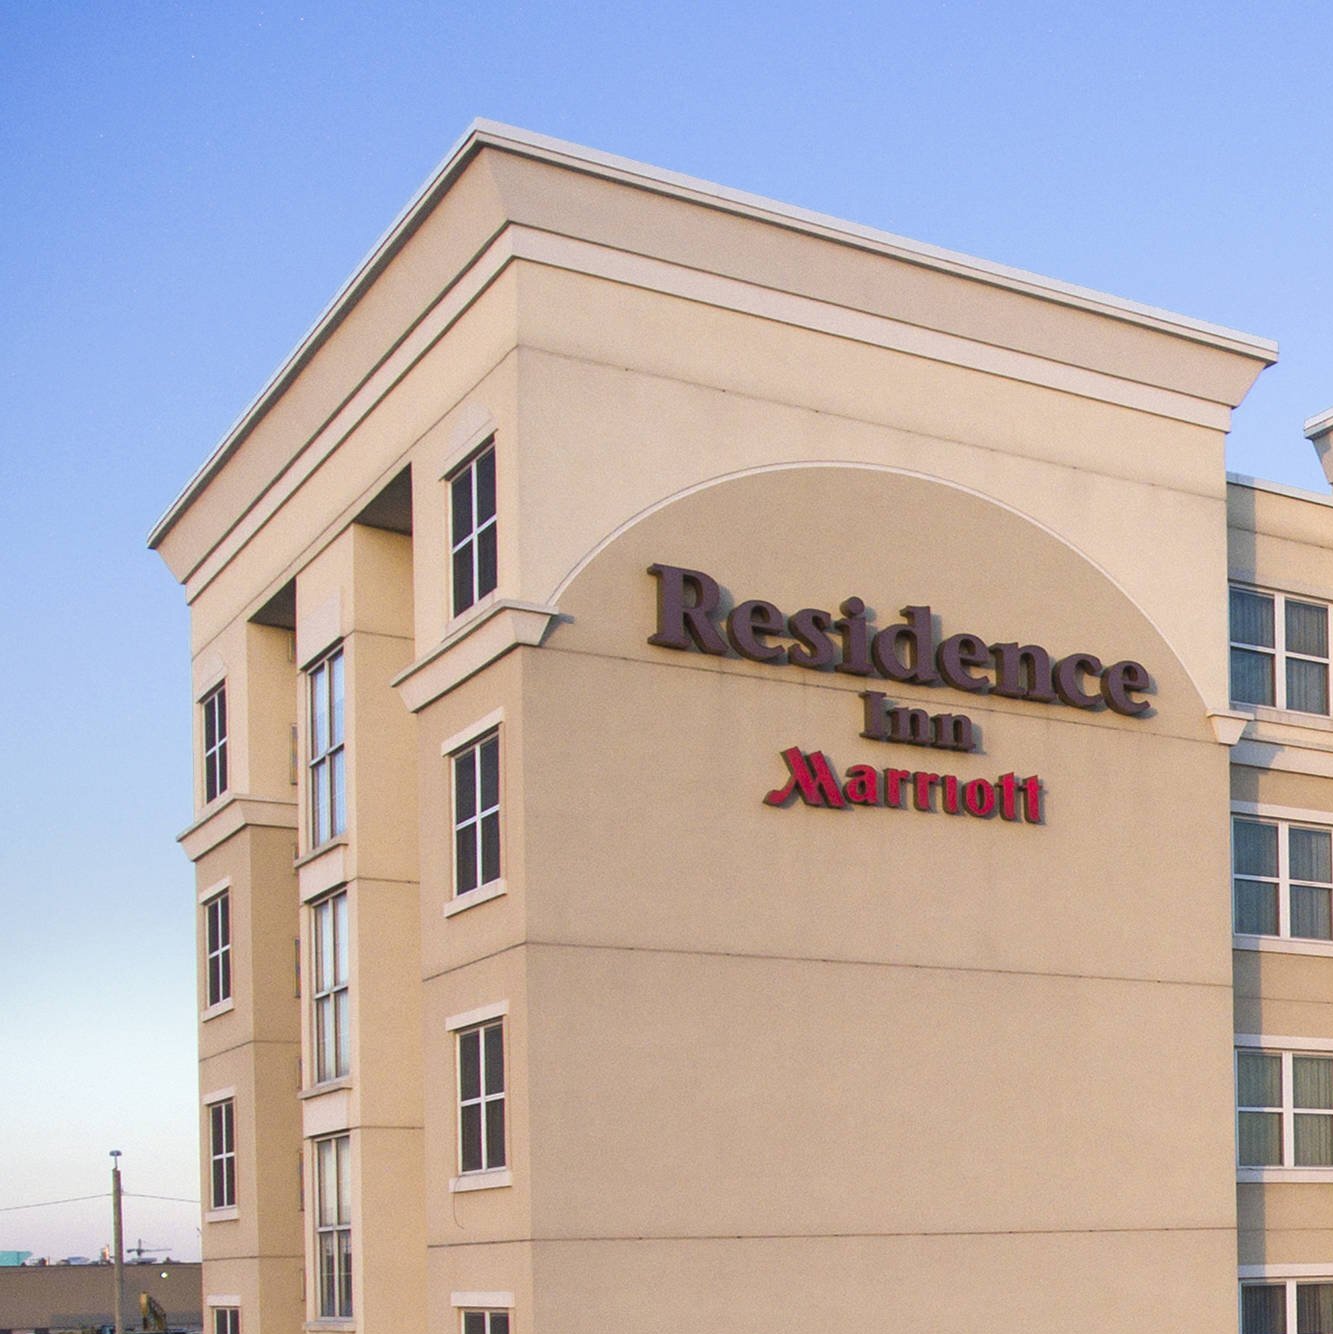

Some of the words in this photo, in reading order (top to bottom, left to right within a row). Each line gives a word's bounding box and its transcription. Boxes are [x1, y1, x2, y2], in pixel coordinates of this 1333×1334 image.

[647, 563, 1154, 716] Residence
[859, 691, 979, 752] Inn
[765, 747, 1045, 823] Marriott
